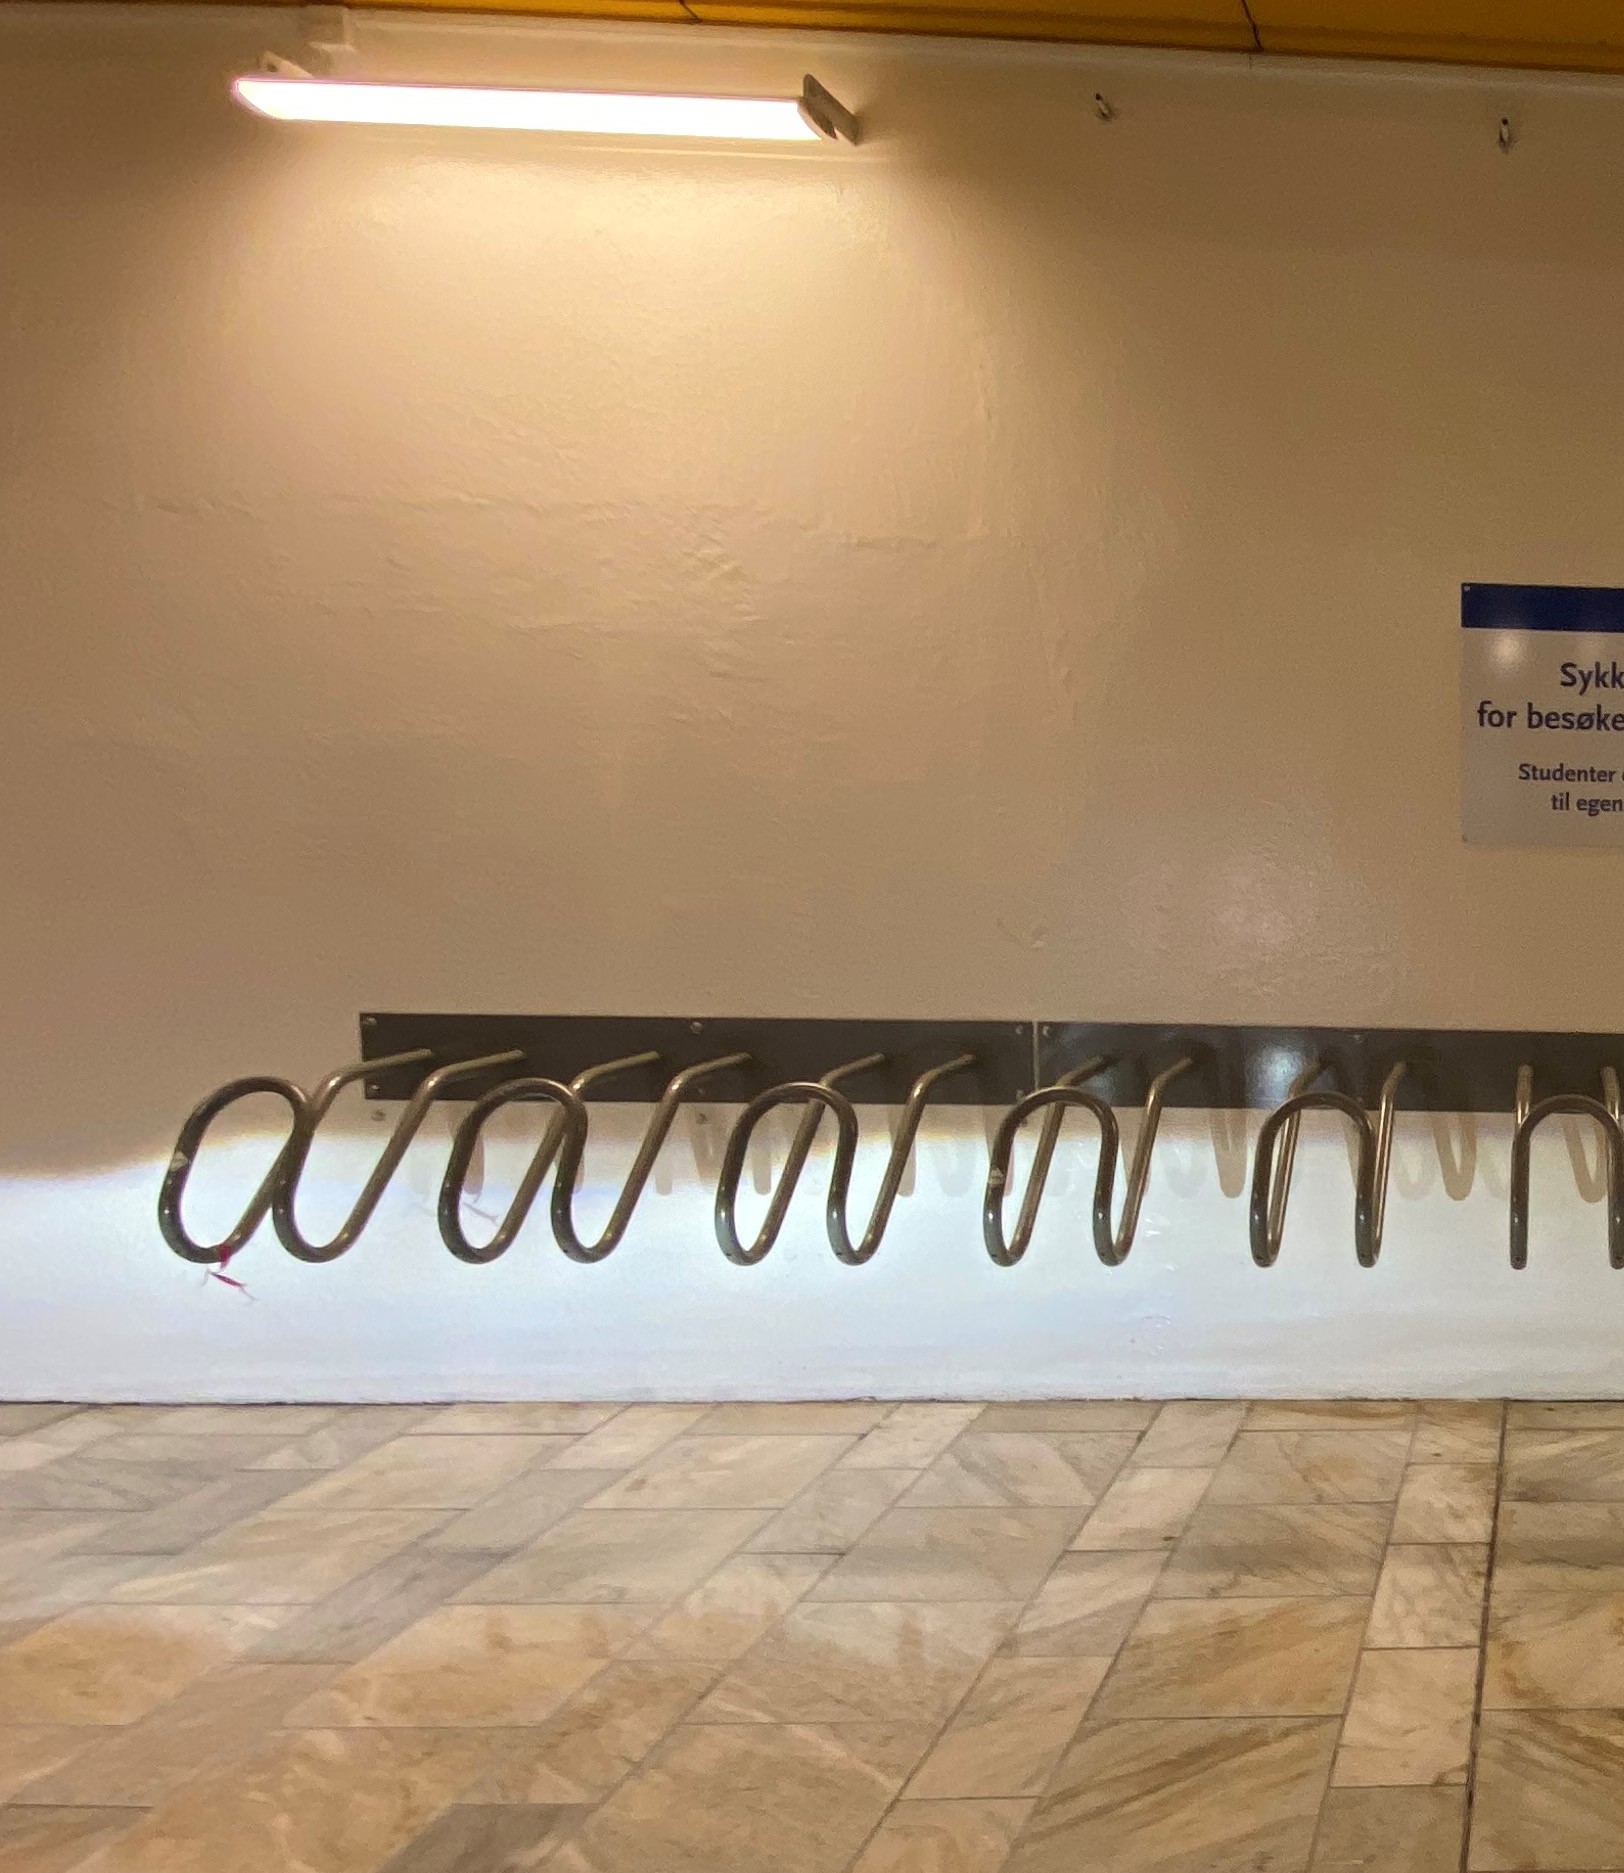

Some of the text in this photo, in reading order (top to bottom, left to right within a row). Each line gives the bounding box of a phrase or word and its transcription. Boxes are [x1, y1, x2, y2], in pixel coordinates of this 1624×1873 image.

[1476, 701, 1517, 728] for
[1519, 763, 1615, 783] Studenter
[1551, 793, 1570, 812] til
[1576, 799, 1624, 818] egen
